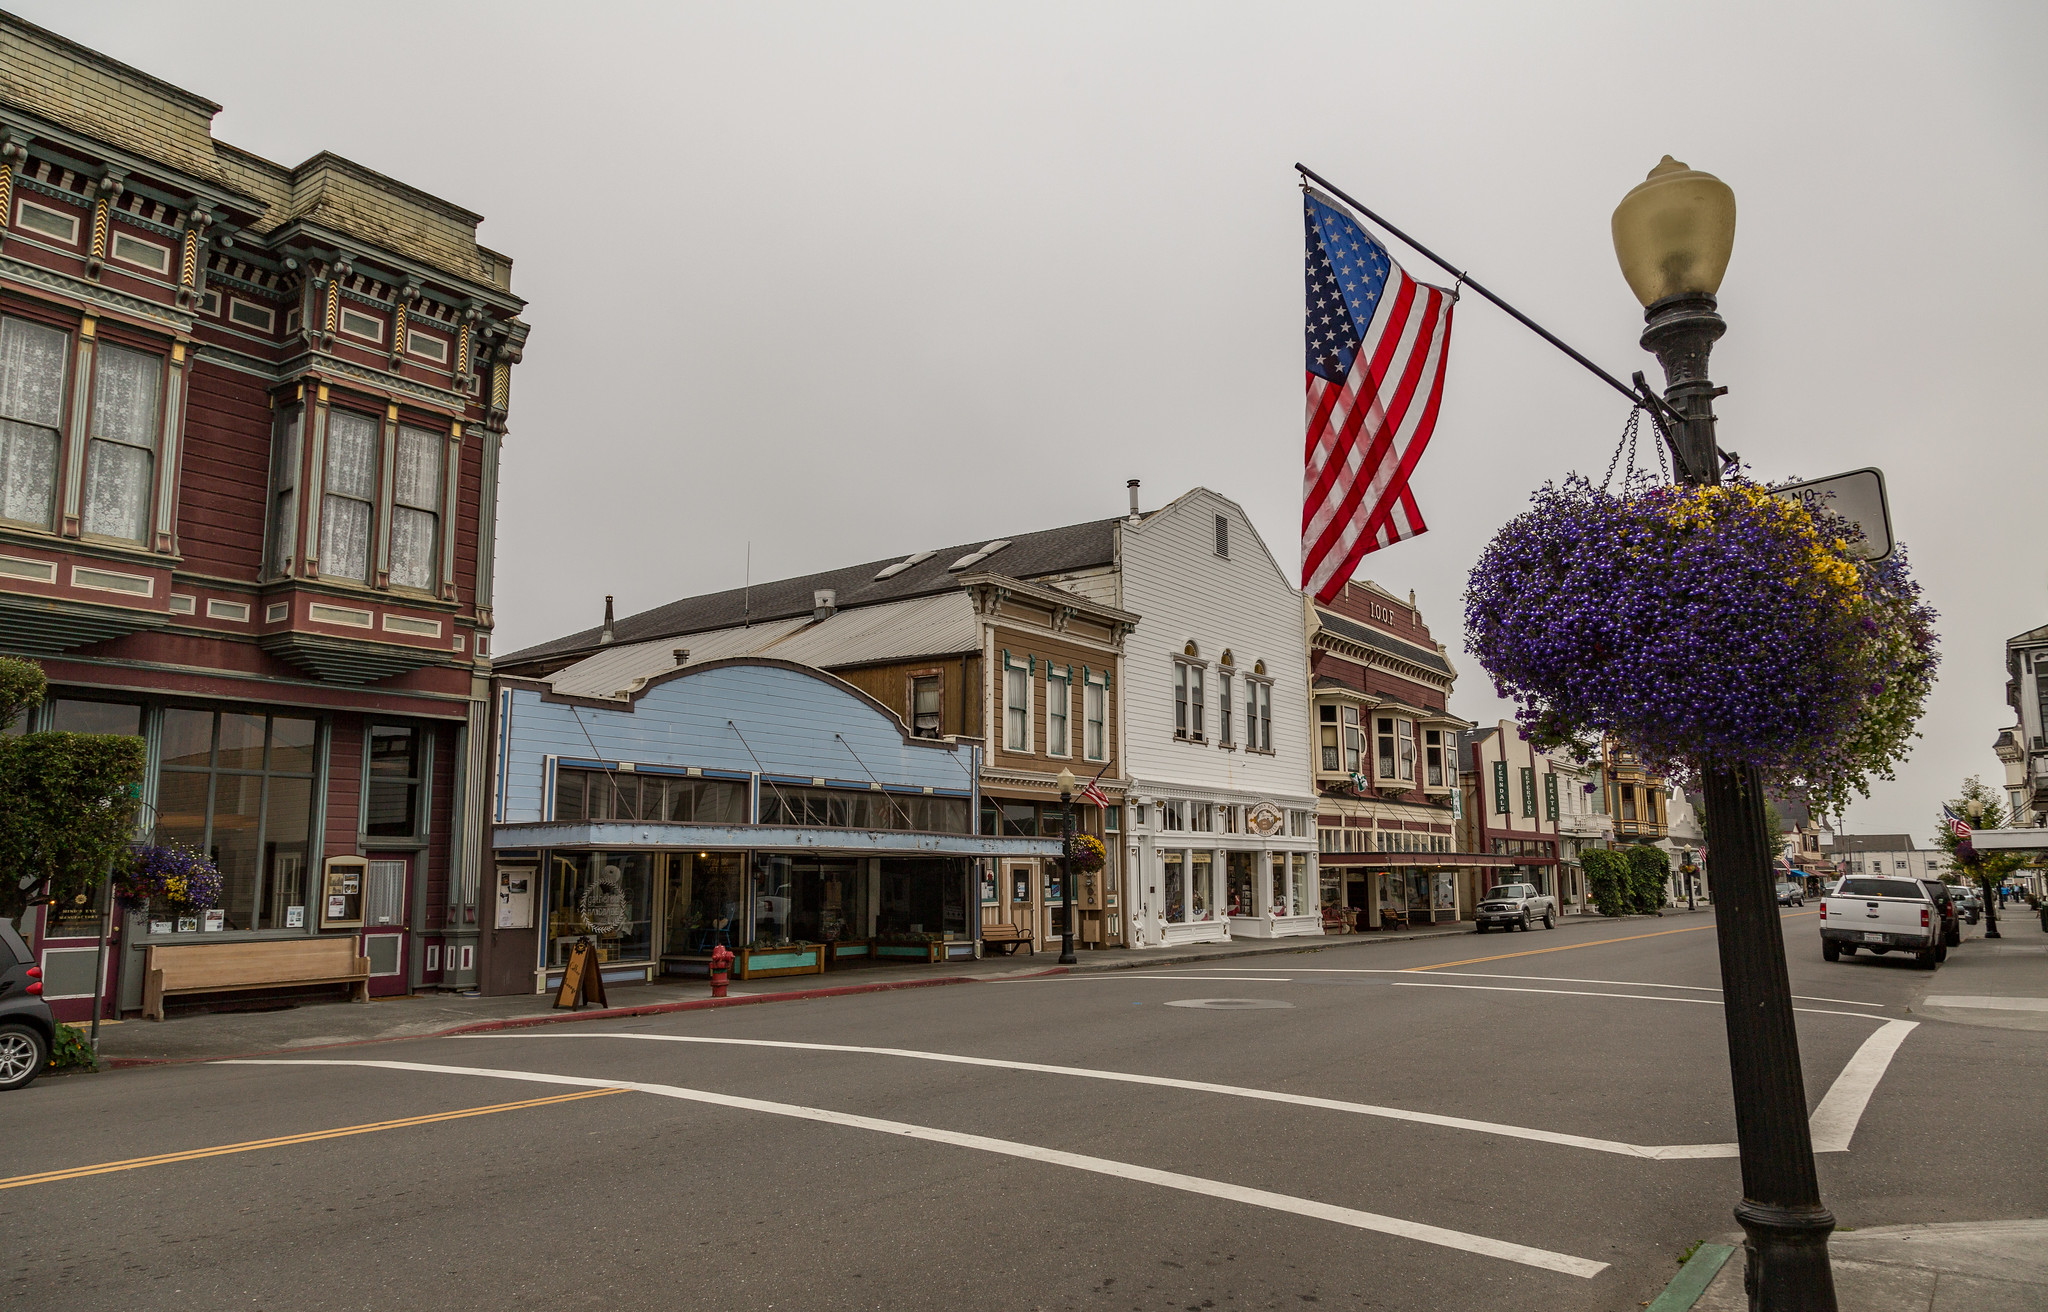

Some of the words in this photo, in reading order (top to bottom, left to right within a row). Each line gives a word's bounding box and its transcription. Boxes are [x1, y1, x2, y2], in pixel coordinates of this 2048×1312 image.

[1792, 489, 1815, 502] NO
[1497, 764, 1506, 812] FERNDALE
[1524, 770, 1533, 815] REPERTORY
[1548, 776, 1556, 818] THEATRE
